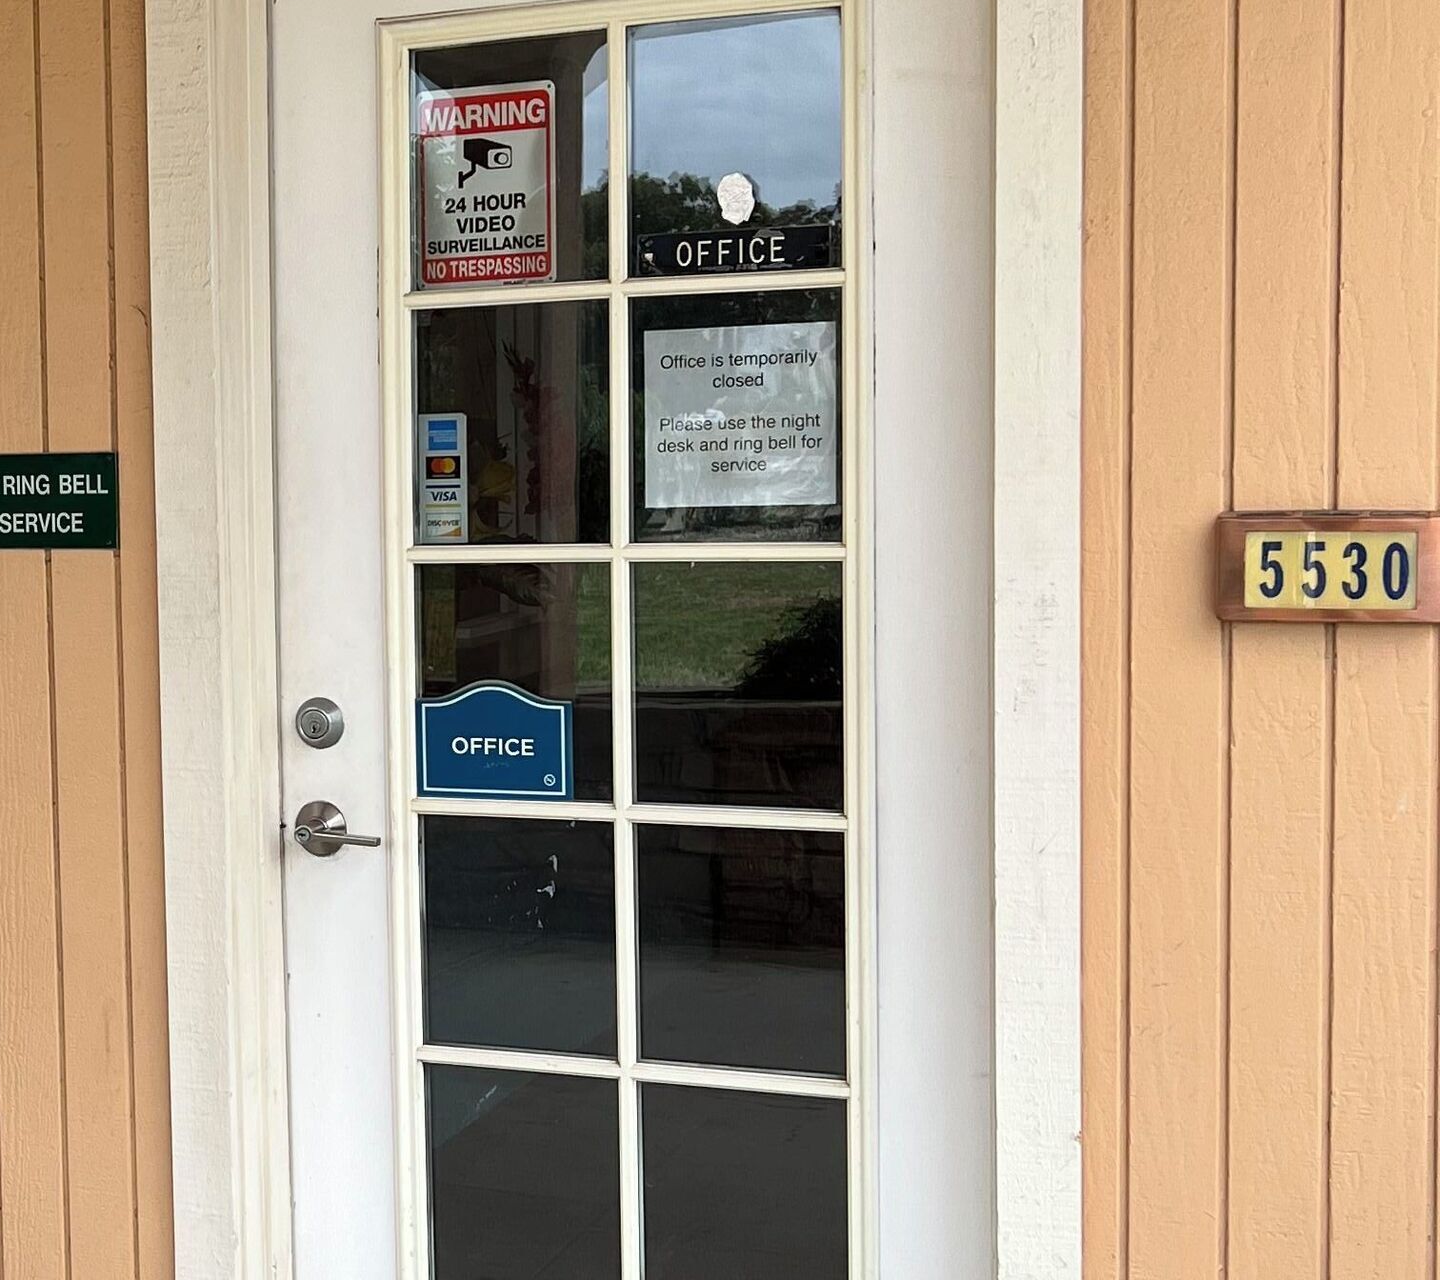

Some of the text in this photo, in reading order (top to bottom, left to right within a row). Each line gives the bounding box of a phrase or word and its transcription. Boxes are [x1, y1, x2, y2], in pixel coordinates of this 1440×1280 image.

[424, 98, 546, 132] WARNING
[444, 192, 526, 214] 24 HOUR
[456, 215, 515, 234] VIDEO
[427, 234, 545, 255] SURVEILLANCE
[676, 236, 786, 267] OFFICE
[426, 255, 547, 280] NO TRESPASSING
[660, 349, 818, 370] Office is temporarily
[712, 373, 764, 388] closed
[659, 413, 821, 432] Please use the night
[657, 434, 823, 453] desk and ring bell for
[710, 457, 767, 473] service
[2, 474, 50, 496] RING
[59, 474, 109, 495] BELL
[431, 491, 457, 502] VISA
[1259, 541, 1410, 600] 5530
[451, 736, 535, 756] OFFICE
